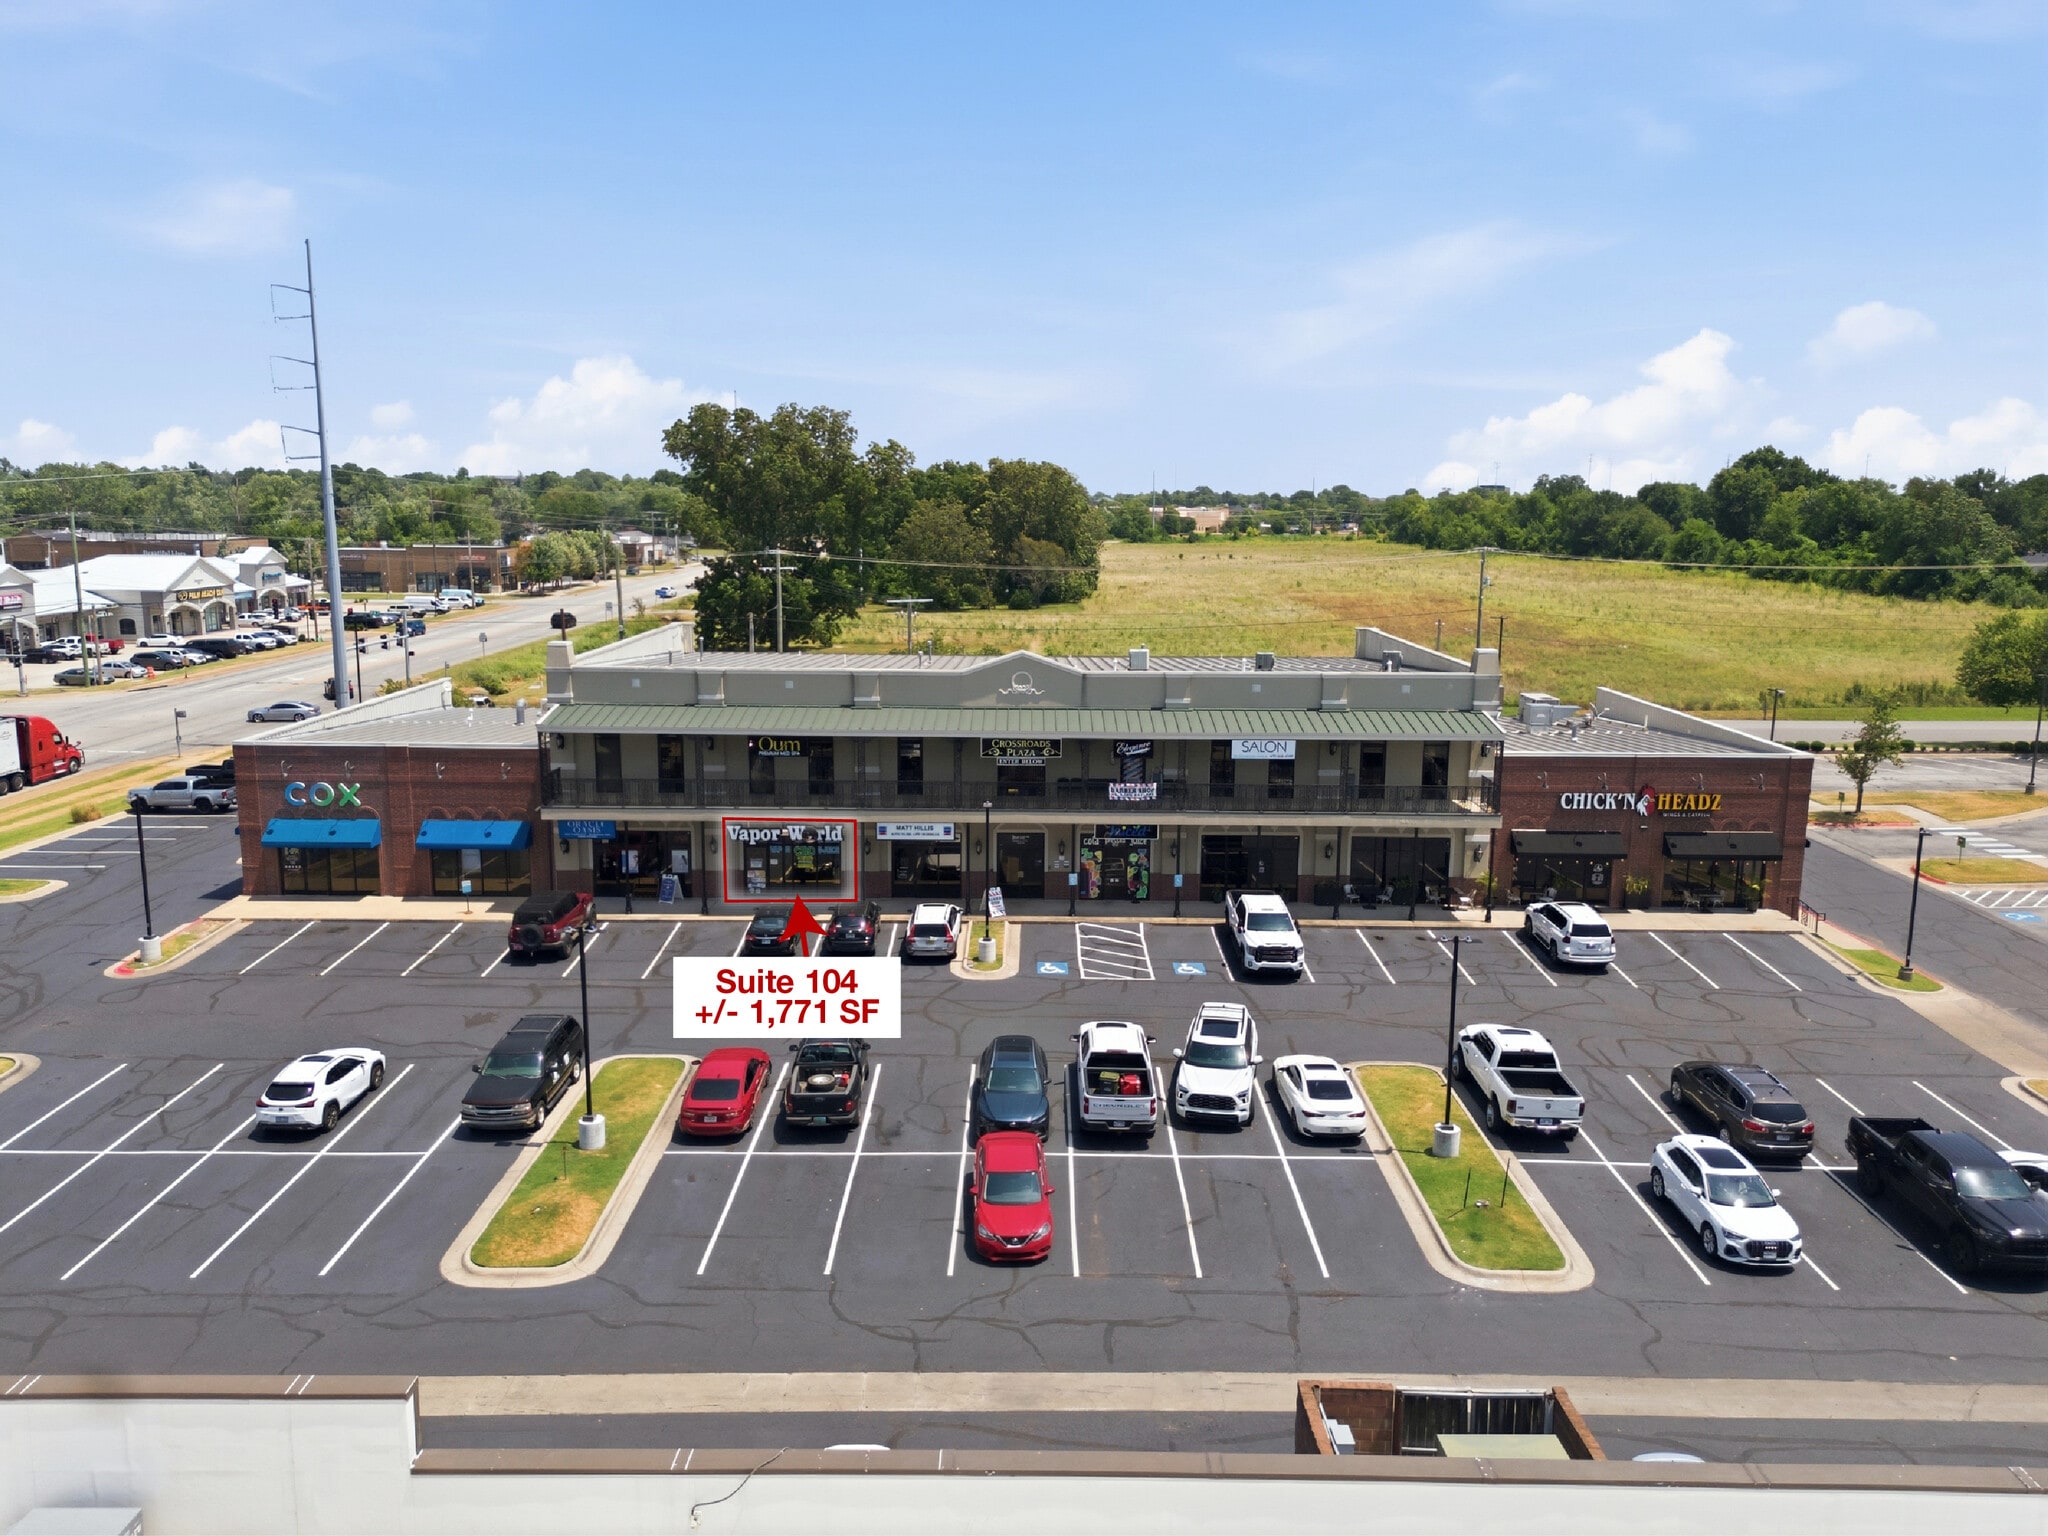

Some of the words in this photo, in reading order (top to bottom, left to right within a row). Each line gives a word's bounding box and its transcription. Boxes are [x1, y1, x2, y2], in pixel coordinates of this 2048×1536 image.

[991, 739, 1051, 749] CROSSROADS
[1241, 740, 1287, 753] SALON
[1007, 748, 1036, 757] PLAZA
[284, 781, 362, 807] COX
[1560, 792, 1636, 810] CHICK'N
[1656, 793, 1722, 811] HEADZ
[727, 825, 781, 845] Vapor
